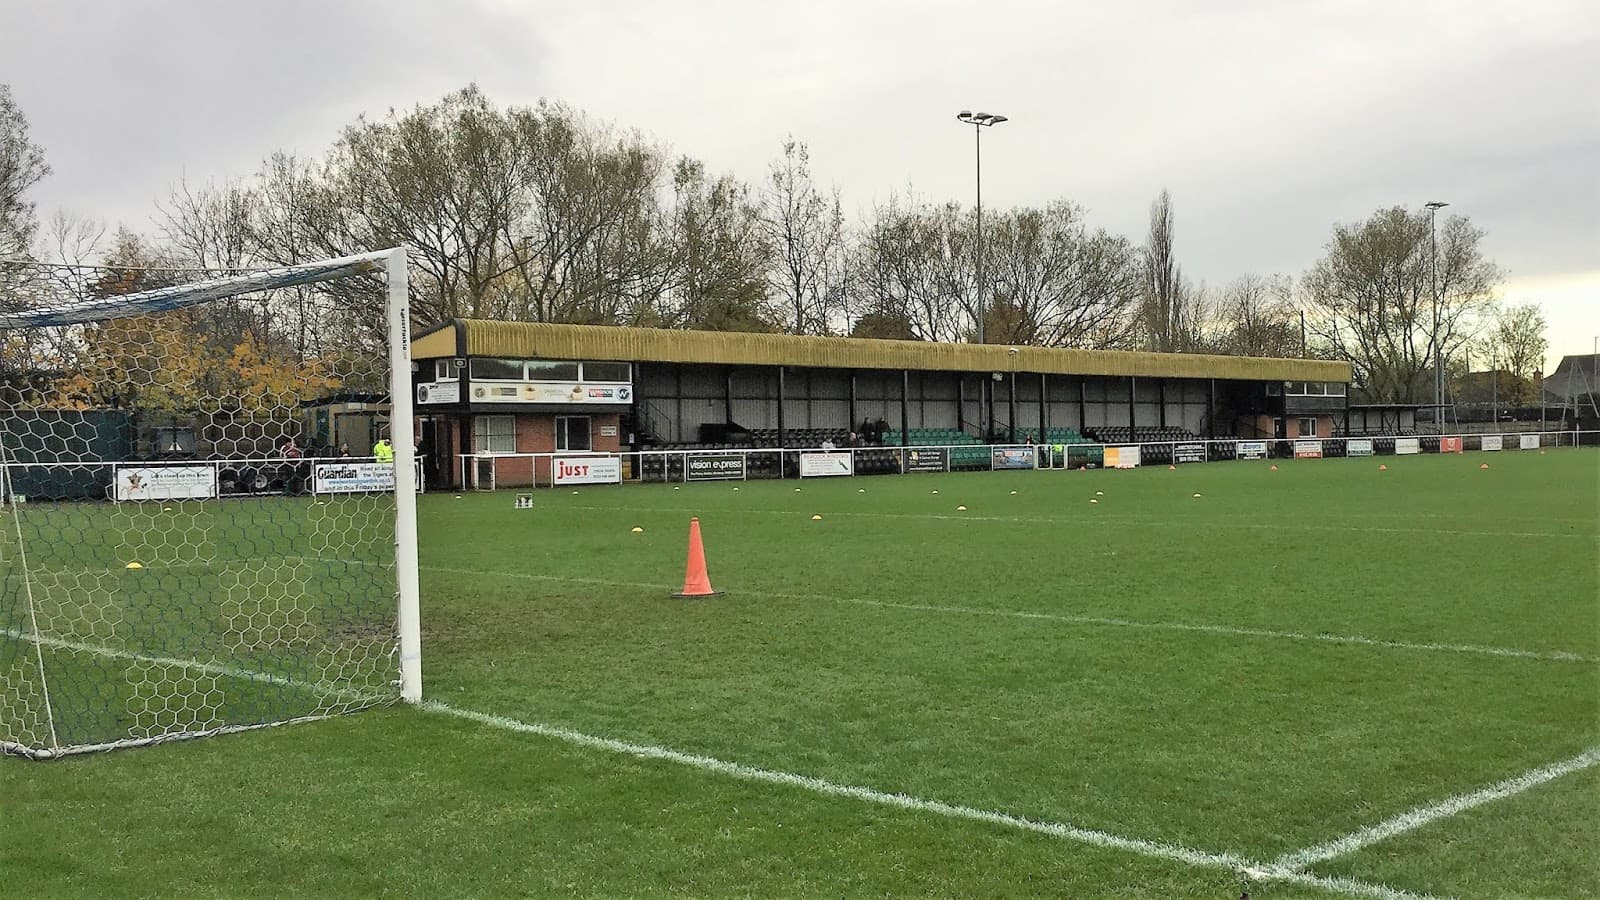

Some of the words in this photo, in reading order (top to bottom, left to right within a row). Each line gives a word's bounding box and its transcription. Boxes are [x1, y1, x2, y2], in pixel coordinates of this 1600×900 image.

[690, 459, 711, 469] vision
[713, 460, 742, 470] express
[318, 466, 357, 479] Guardian
